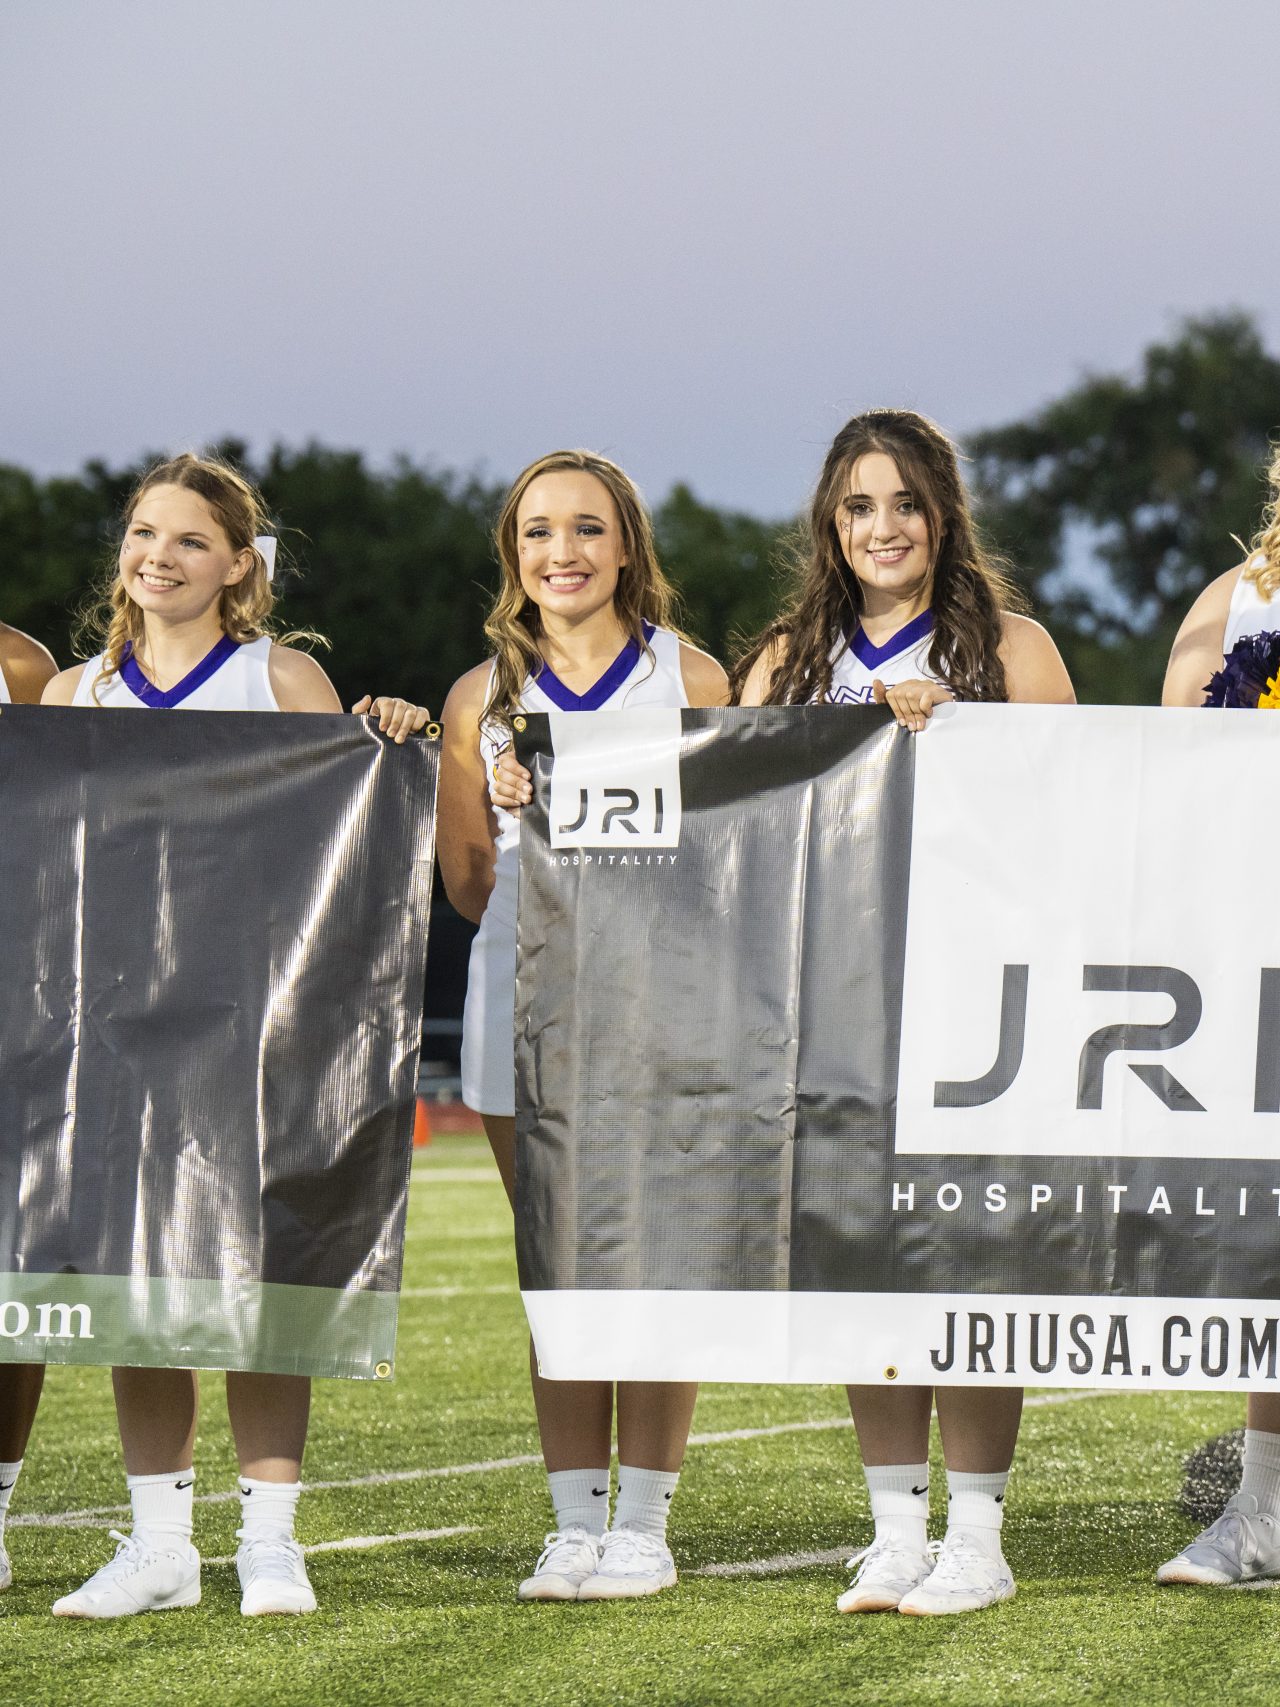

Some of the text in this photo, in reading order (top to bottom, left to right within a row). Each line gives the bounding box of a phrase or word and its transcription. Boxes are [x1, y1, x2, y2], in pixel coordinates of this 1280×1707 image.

[558, 788, 664, 834] JRI
[549, 854, 678, 867] HOSPITALITY
[929, 1311, 1280, 1380] JRIUSA.COM
